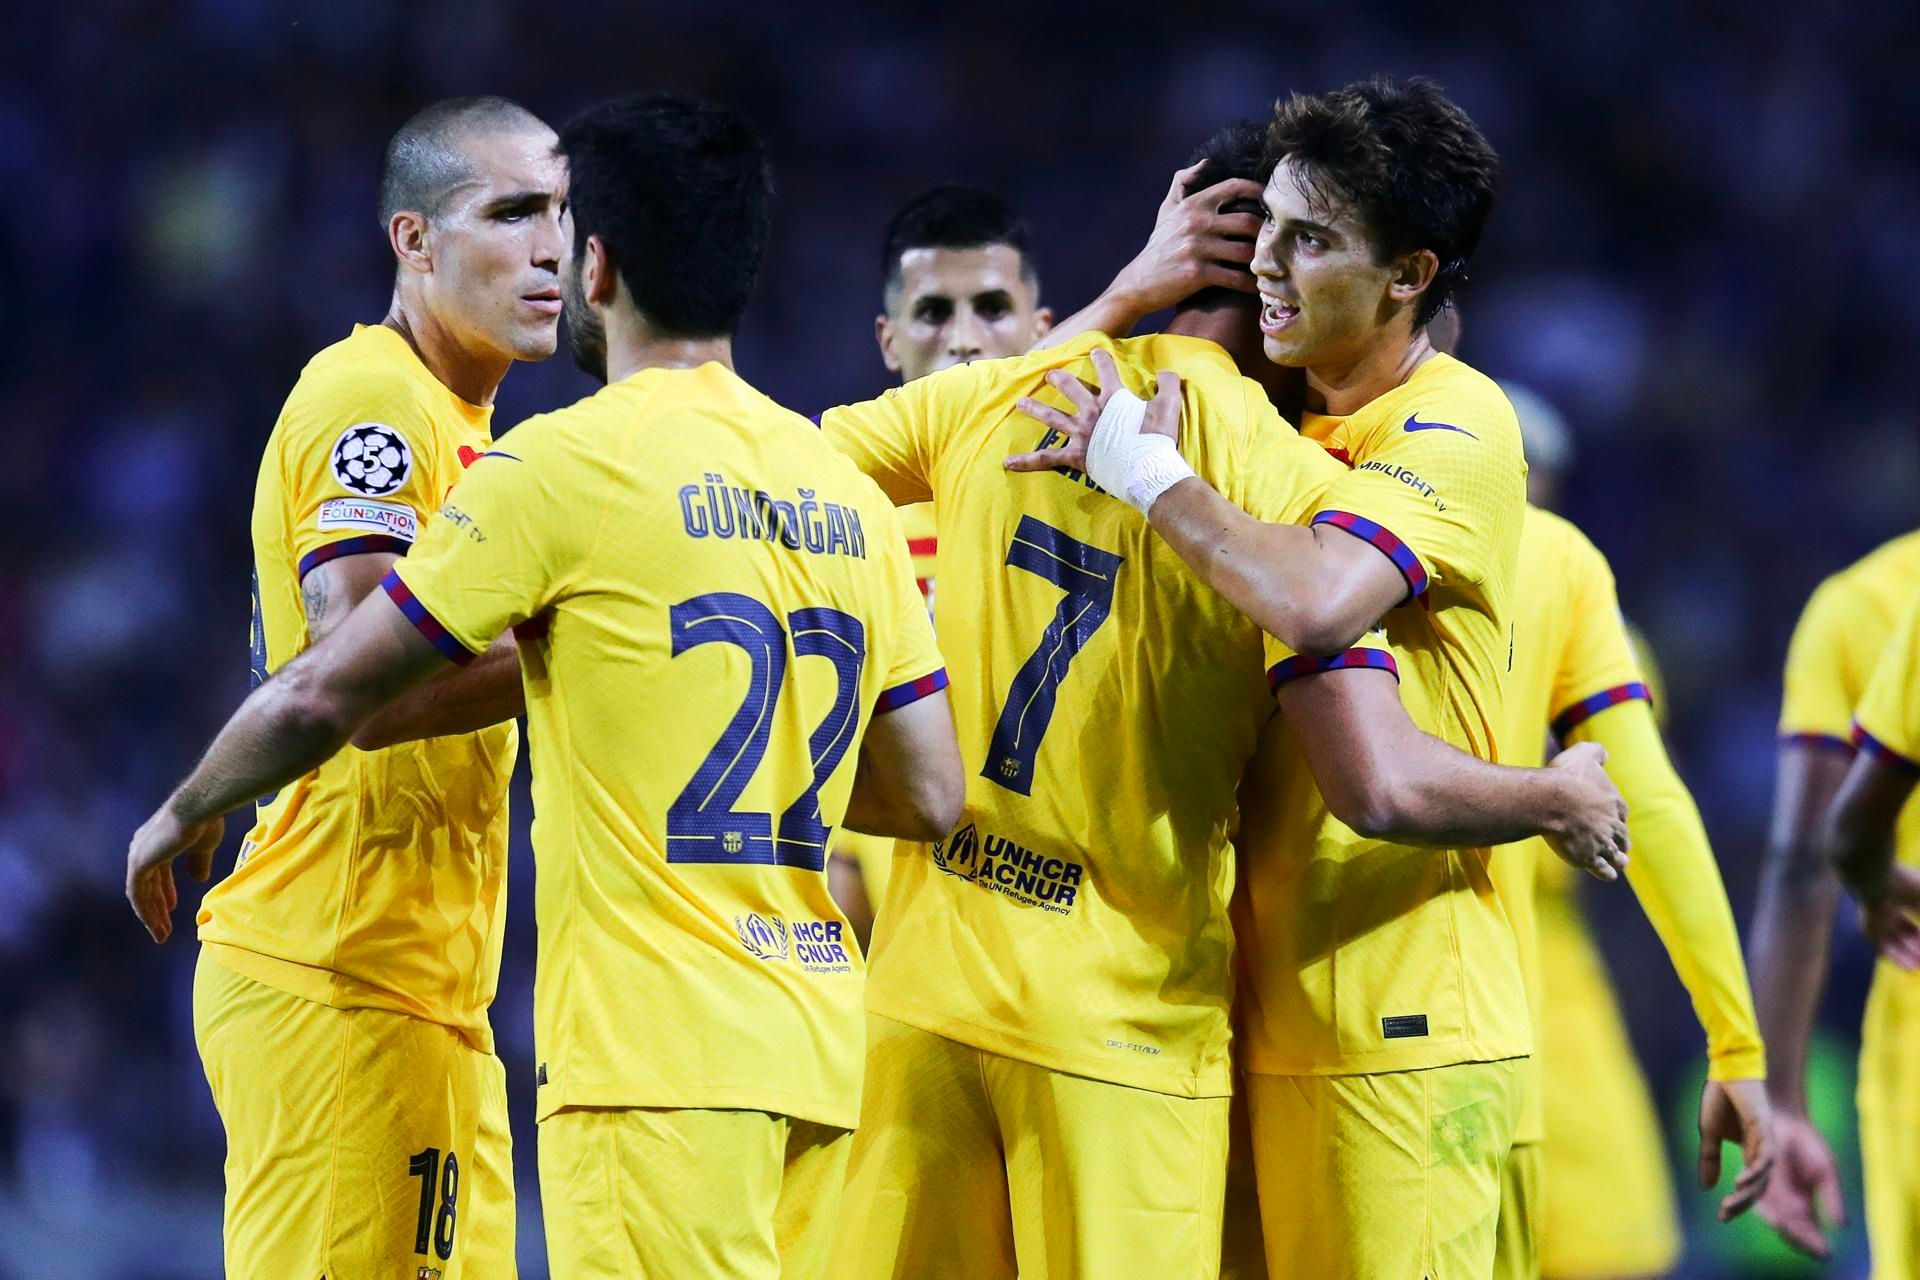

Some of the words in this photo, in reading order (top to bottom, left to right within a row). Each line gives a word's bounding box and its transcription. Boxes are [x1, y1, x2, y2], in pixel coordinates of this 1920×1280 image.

[362, 444, 382, 474] 5
[1360, 461, 1435, 498] MBILIGHT
[979, 514, 1126, 797] 7
[667, 592, 866, 872] 22
[983, 834, 1083, 886] UNHCR
[978, 857, 1077, 907] ACNUR
[988, 882, 1003, 893] UN
[1003, 886, 1038, 907] Refugee
[1038, 901, 1071, 916] Agency
[792, 921, 842, 943] HCR
[796, 943, 849, 963] CNUR
[408, 1147, 459, 1261] 18
